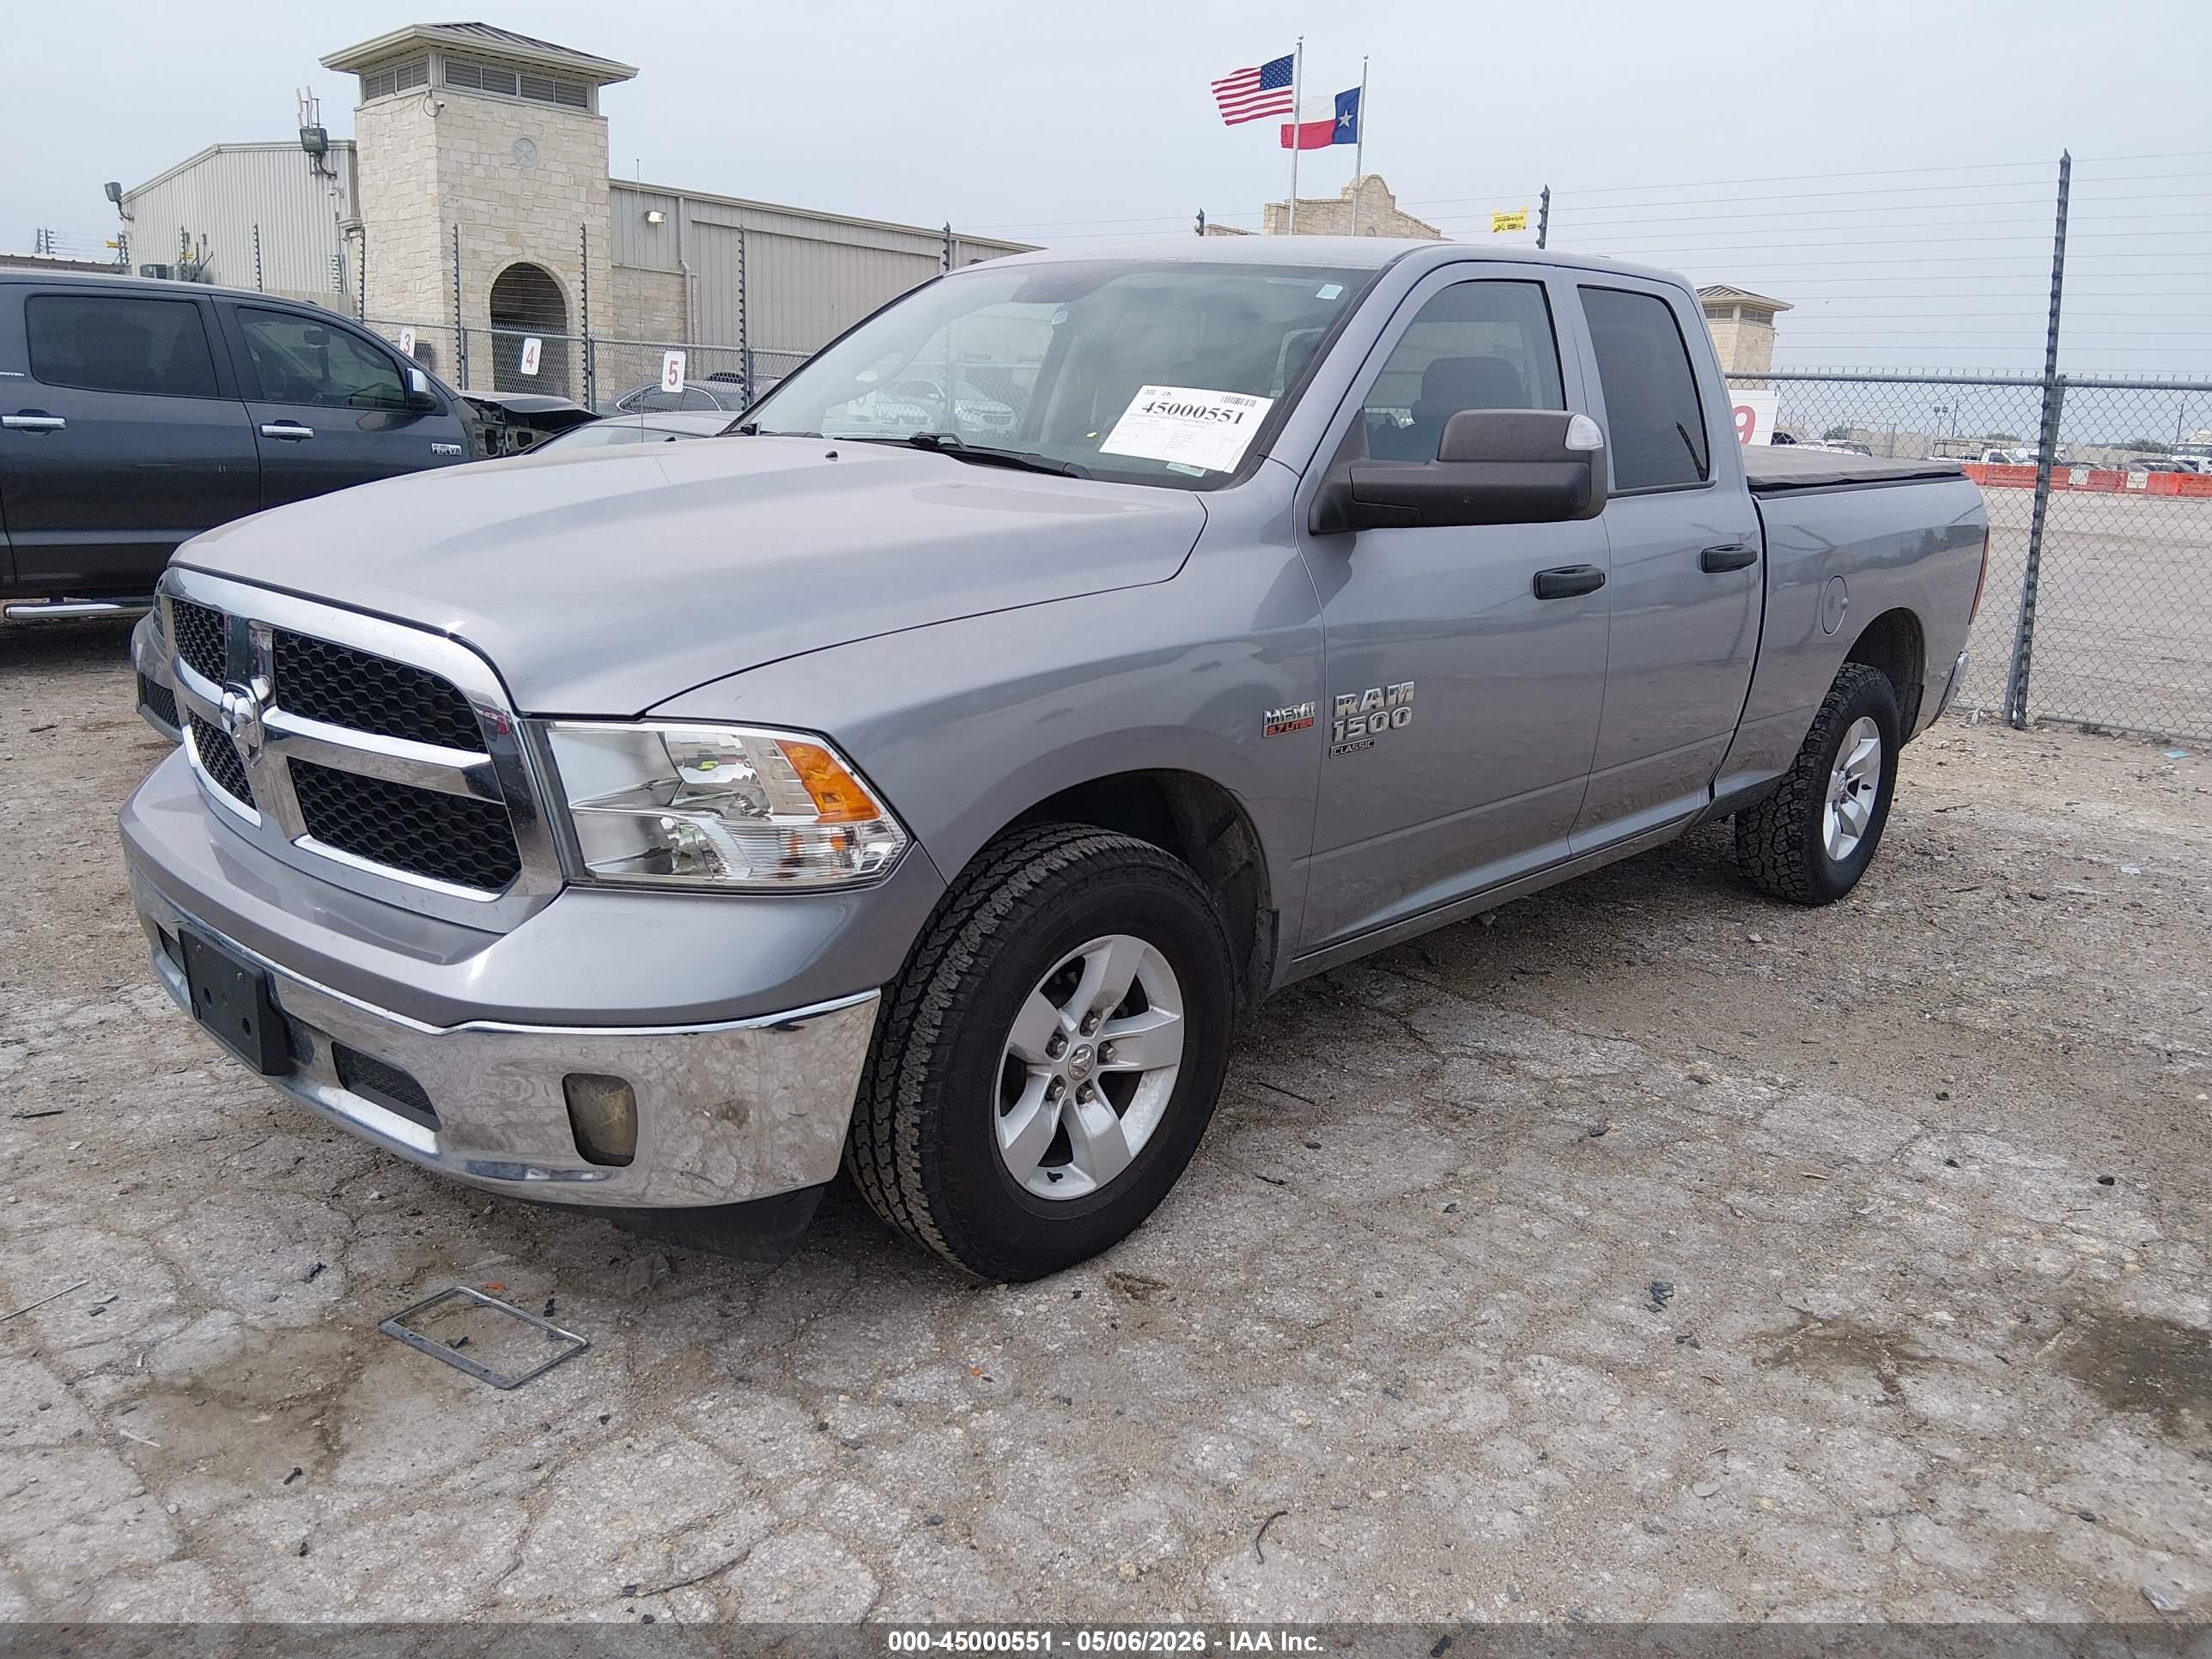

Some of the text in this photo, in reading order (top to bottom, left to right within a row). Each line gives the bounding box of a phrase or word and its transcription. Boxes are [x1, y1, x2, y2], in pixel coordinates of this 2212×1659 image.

[404, 333, 411, 353] 3
[526, 345, 535, 369] 4
[668, 360, 678, 386] 5
[1141, 400, 1245, 424] 45000551
[1333, 680, 1415, 718] RAM
[1263, 701, 1316, 725] HEMI
[1332, 706, 1413, 743] 1500
[1332, 739, 1375, 757] CLASSIC
